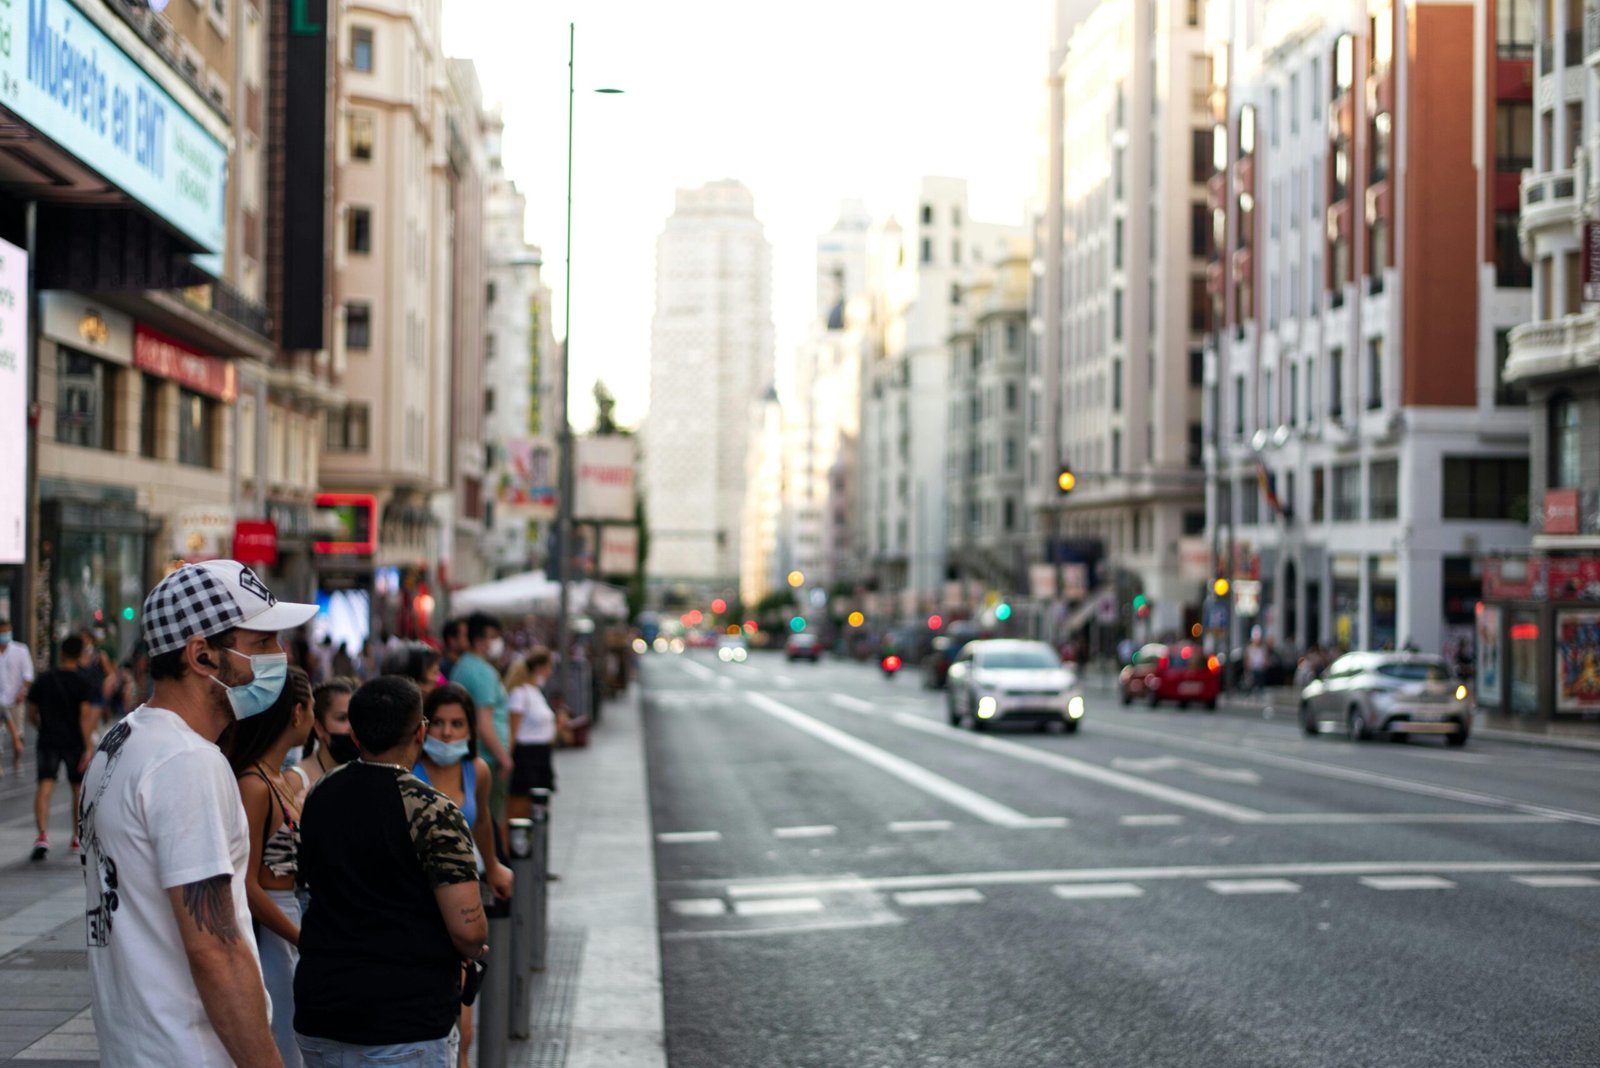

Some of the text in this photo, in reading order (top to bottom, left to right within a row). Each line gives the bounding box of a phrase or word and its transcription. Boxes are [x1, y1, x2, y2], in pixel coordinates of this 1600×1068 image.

[27, 0, 107, 137] Muévete
[112, 83, 131, 156] en
[135, 81, 166, 181] EMT
